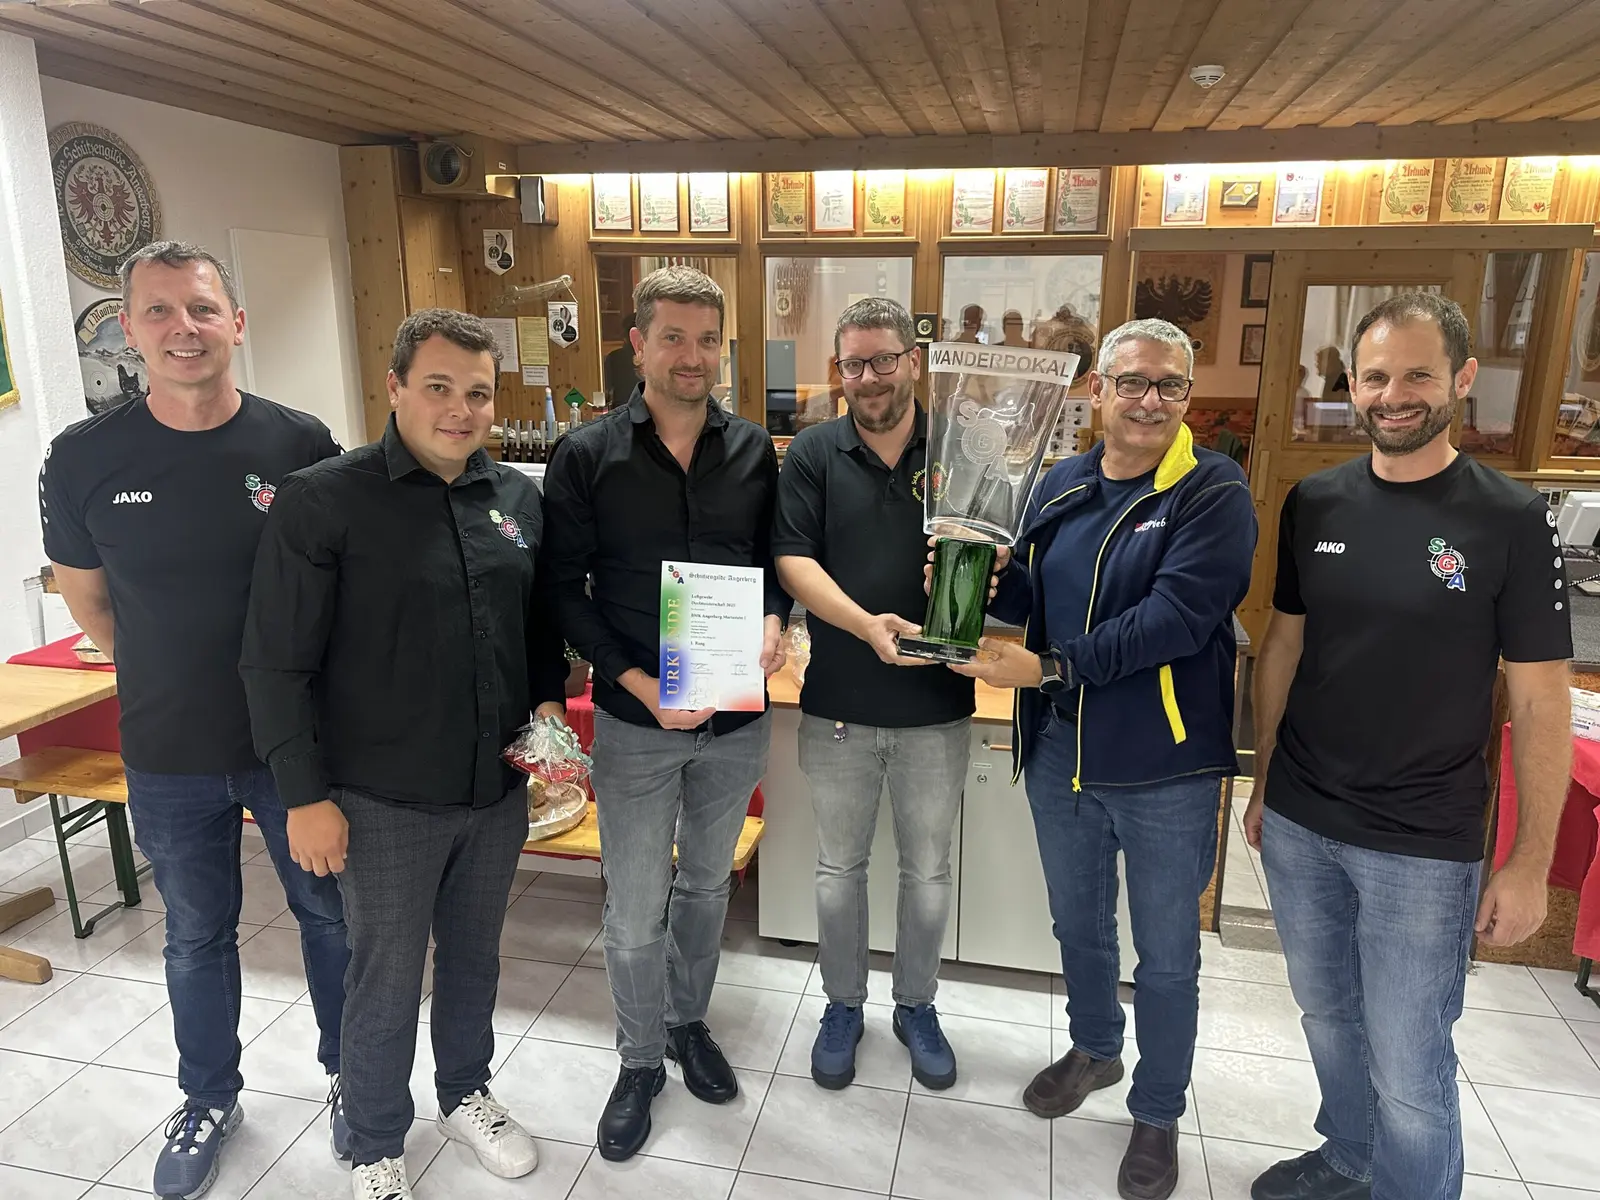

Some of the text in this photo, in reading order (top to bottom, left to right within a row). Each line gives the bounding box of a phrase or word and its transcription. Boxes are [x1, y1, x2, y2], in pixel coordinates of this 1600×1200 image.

[63, 140, 126, 169] Schützengilde
[930, 350, 1070, 379] WANDERPOKAL
[112, 491, 153, 504] JAKO
[1314, 541, 1346, 555] JAKO
[727, 575, 757, 583] Angerberg
[666, 598, 681, 696] URKUNDE
